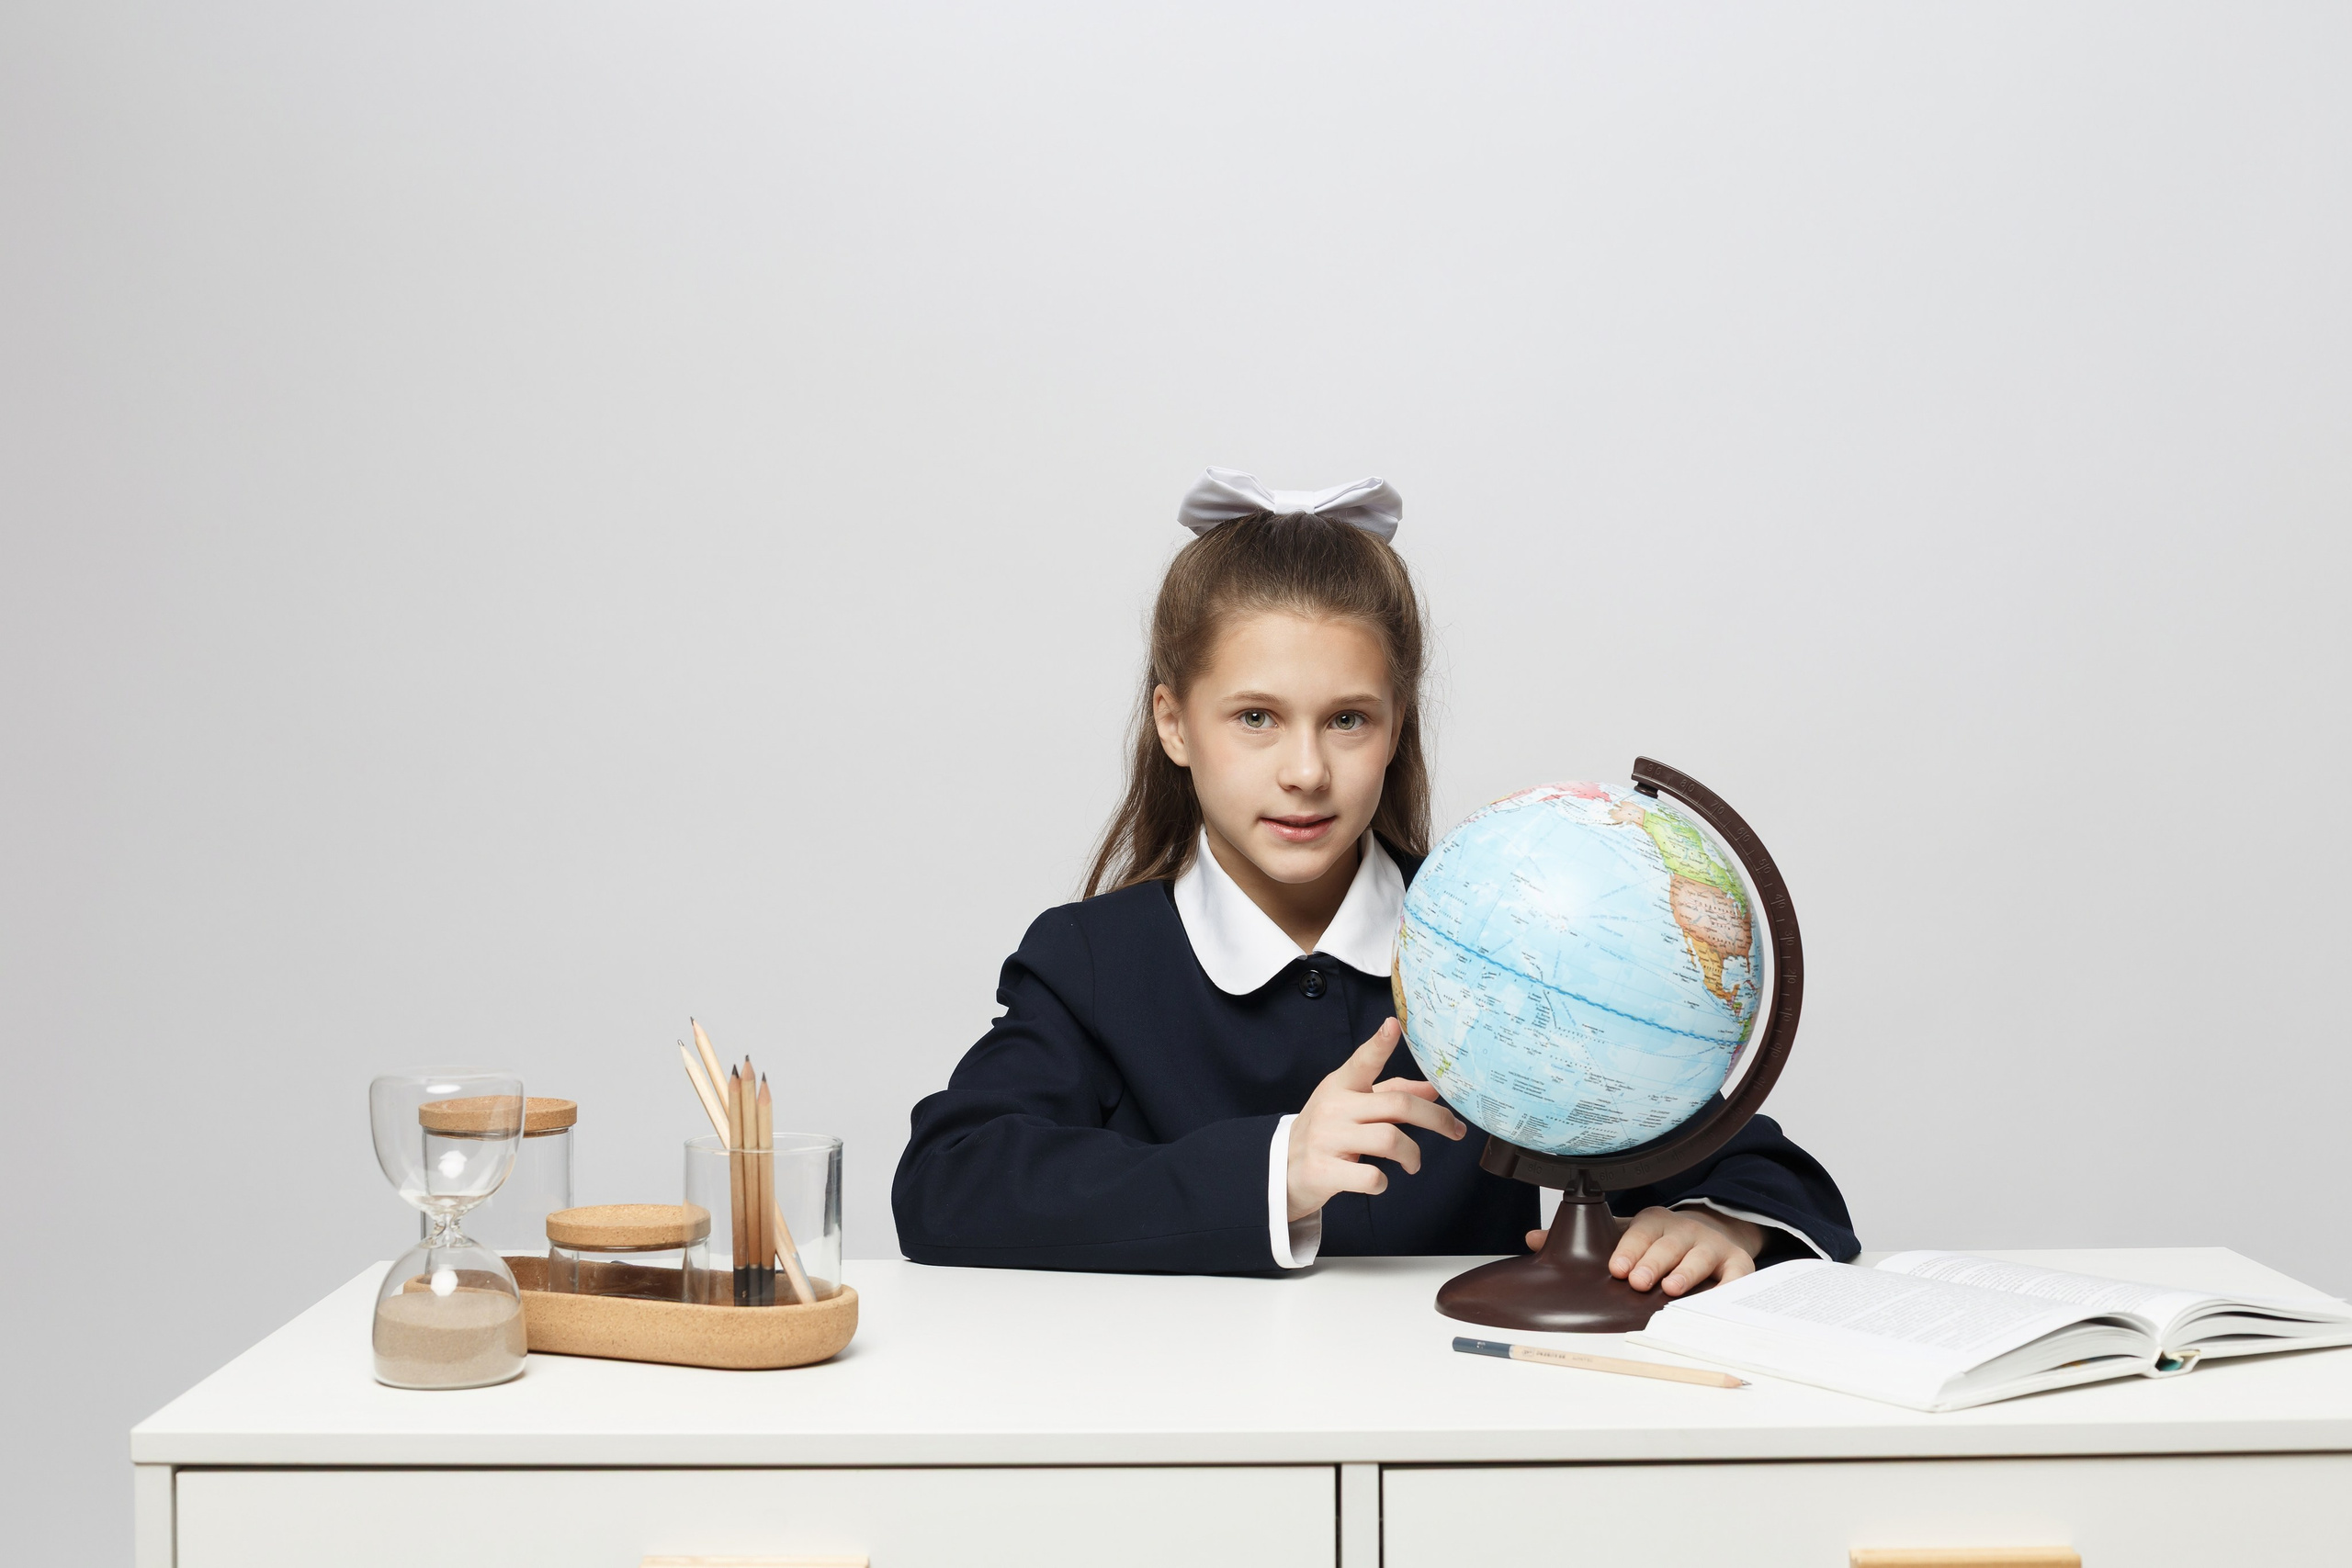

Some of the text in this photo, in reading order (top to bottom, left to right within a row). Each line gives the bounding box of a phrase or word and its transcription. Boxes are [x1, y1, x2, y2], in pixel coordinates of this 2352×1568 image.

[1646, 763, 1662, 775] 90
[1679, 779, 1695, 792] 80
[1710, 799, 1724, 815] 70
[1736, 827, 1750, 842] 60
[1758, 858, 1771, 874] 50
[1775, 894, 1787, 908] 40
[1784, 930, 1794, 946] 30
[1787, 968, 1797, 984] 20
[1782, 1007, 1793, 1021] 10
[1600, 1171, 1614, 1181] 60
